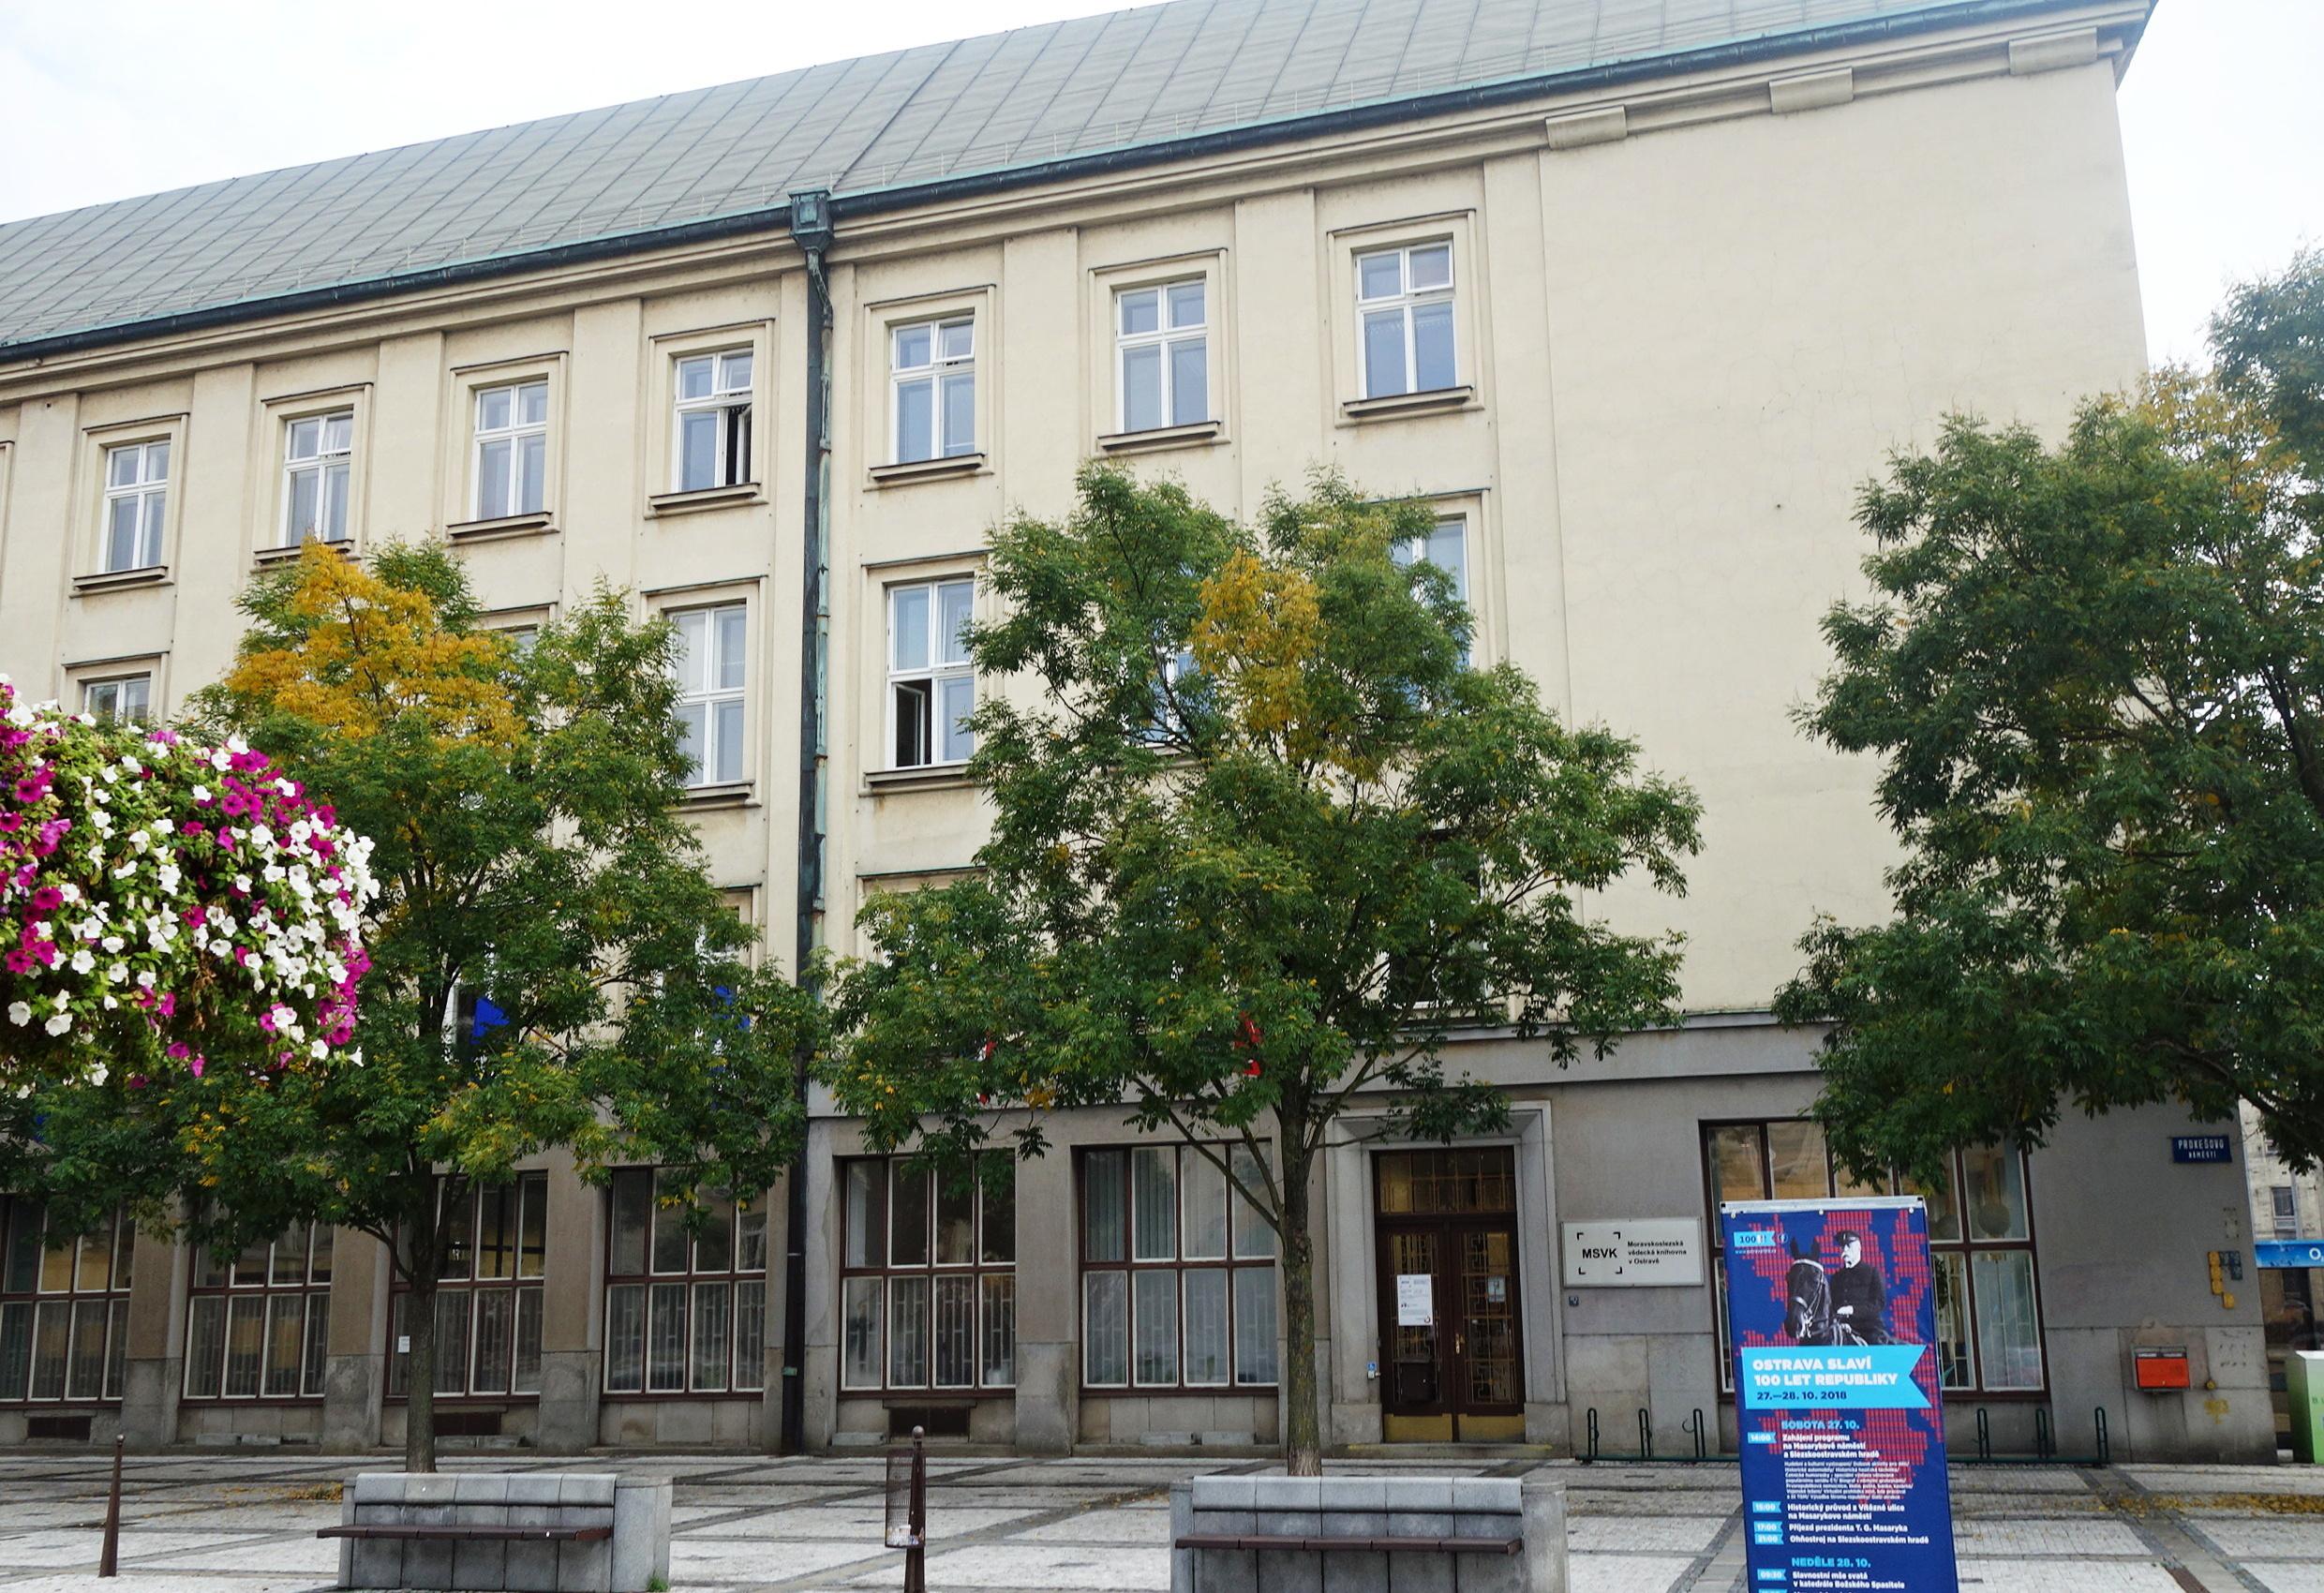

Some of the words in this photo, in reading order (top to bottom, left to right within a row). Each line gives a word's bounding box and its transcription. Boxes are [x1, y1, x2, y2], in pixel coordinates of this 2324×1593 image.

[2178, 1138, 2224, 1150] PROKEŠOVO
[1582, 1247, 1617, 1259] MSVK
[1752, 1358, 1824, 1371] OSTRAVA
[1827, 1355, 1872, 1370] SLAVÍ
[1754, 1375, 1780, 1386] 100
[1784, 1374, 1810, 1386] LET
[1815, 1373, 1898, 1385] REPUBLIKY
[1821, 1391, 1847, 1400] 2018
[1781, 1420, 1825, 1430] SOBOTA
[1828, 1420, 1842, 1429] 27.
[1844, 1420, 1859, 1429] 10.
[1782, 1434, 1812, 1442] Zahájení
[1837, 1441, 1866, 1450] náměstí
[1858, 1450, 1879, 1458] hradě
[1787, 1503, 1824, 1511] Historický
[1825, 1503, 1851, 1511] průvod
[1798, 1512, 1841, 1521] Masarykovo
[1789, 1524, 1814, 1532] Příjezd
[1815, 1524, 1855, 1532] prezidenta
[1873, 1524, 1908, 1533] Masaryka
[1790, 1535, 1825, 1543] Ohňostroj
[1838, 1535, 1906, 1543] Slezskoostravském
[1792, 1556, 1835, 1567] NEDĚLE
[1837, 1558, 1854, 1567] 28.
[1855, 1558, 1871, 1568] 10.
[1835, 1580, 1870, 1588] Božského
[1871, 1581, 1905, 1589] Spasitele
